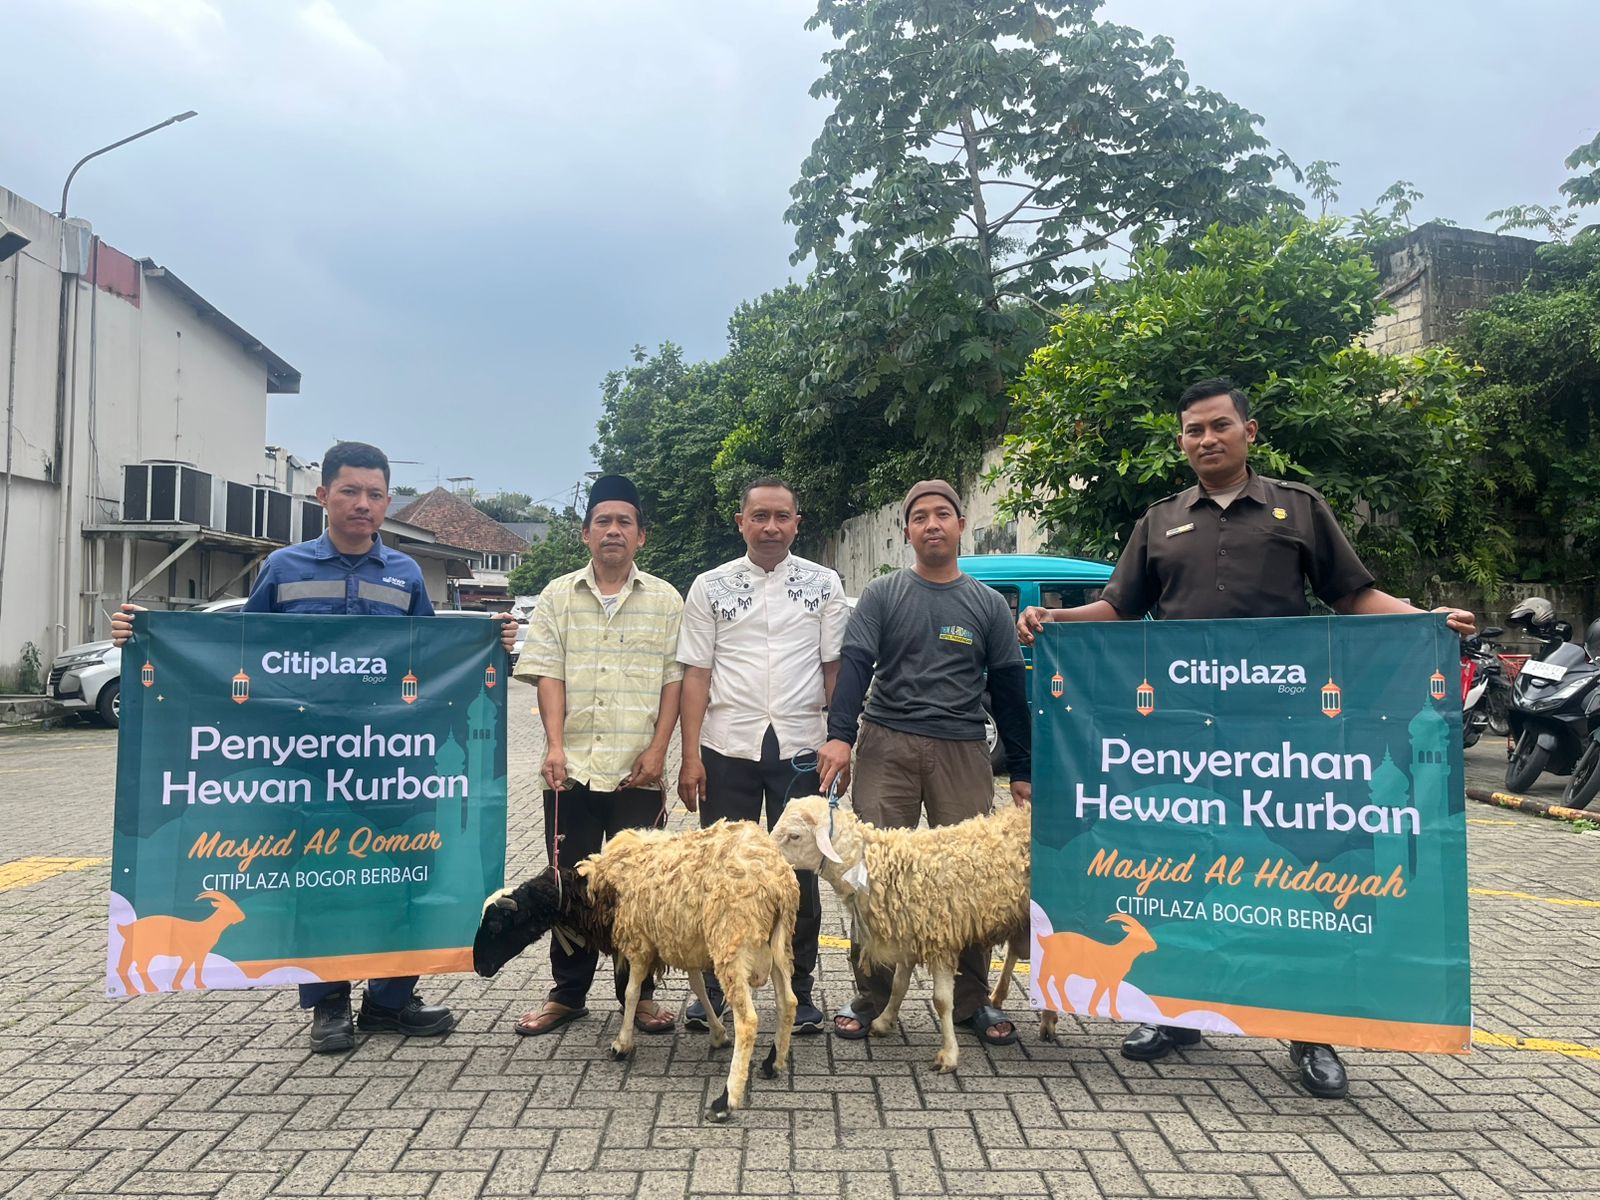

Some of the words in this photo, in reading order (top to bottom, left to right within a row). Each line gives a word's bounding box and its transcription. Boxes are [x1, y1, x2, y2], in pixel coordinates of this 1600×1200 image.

[261, 651, 387, 680] Citiplaza
[361, 674, 387, 685] Bogor
[1168, 659, 1307, 691] Citiplaza
[1277, 683, 1307, 695] Bogor
[190, 725, 436, 766] Penyerahan
[1101, 738, 1372, 783] Penyerahan
[162, 771, 311, 805] Hewan
[326, 767, 469, 802] Kurban
[1075, 783, 1226, 826] Hewan
[1243, 789, 1421, 835] Kurban
[188, 830, 297, 872] Masjid
[304, 827, 340, 856] Al
[347, 827, 442, 858] Qomar
[203, 872, 291, 891] CITIPLAZA
[295, 870, 356, 887] BOGOR
[361, 866, 429, 884] BERBAGI
[1087, 848, 1197, 896] Masjid
[1204, 856, 1244, 886] Al
[1254, 858, 1407, 910] Hidayah
[1115, 896, 1208, 921] CITIPLAZA
[1213, 904, 1283, 926] BOGOR
[1288, 910, 1373, 935] BERBAGI
